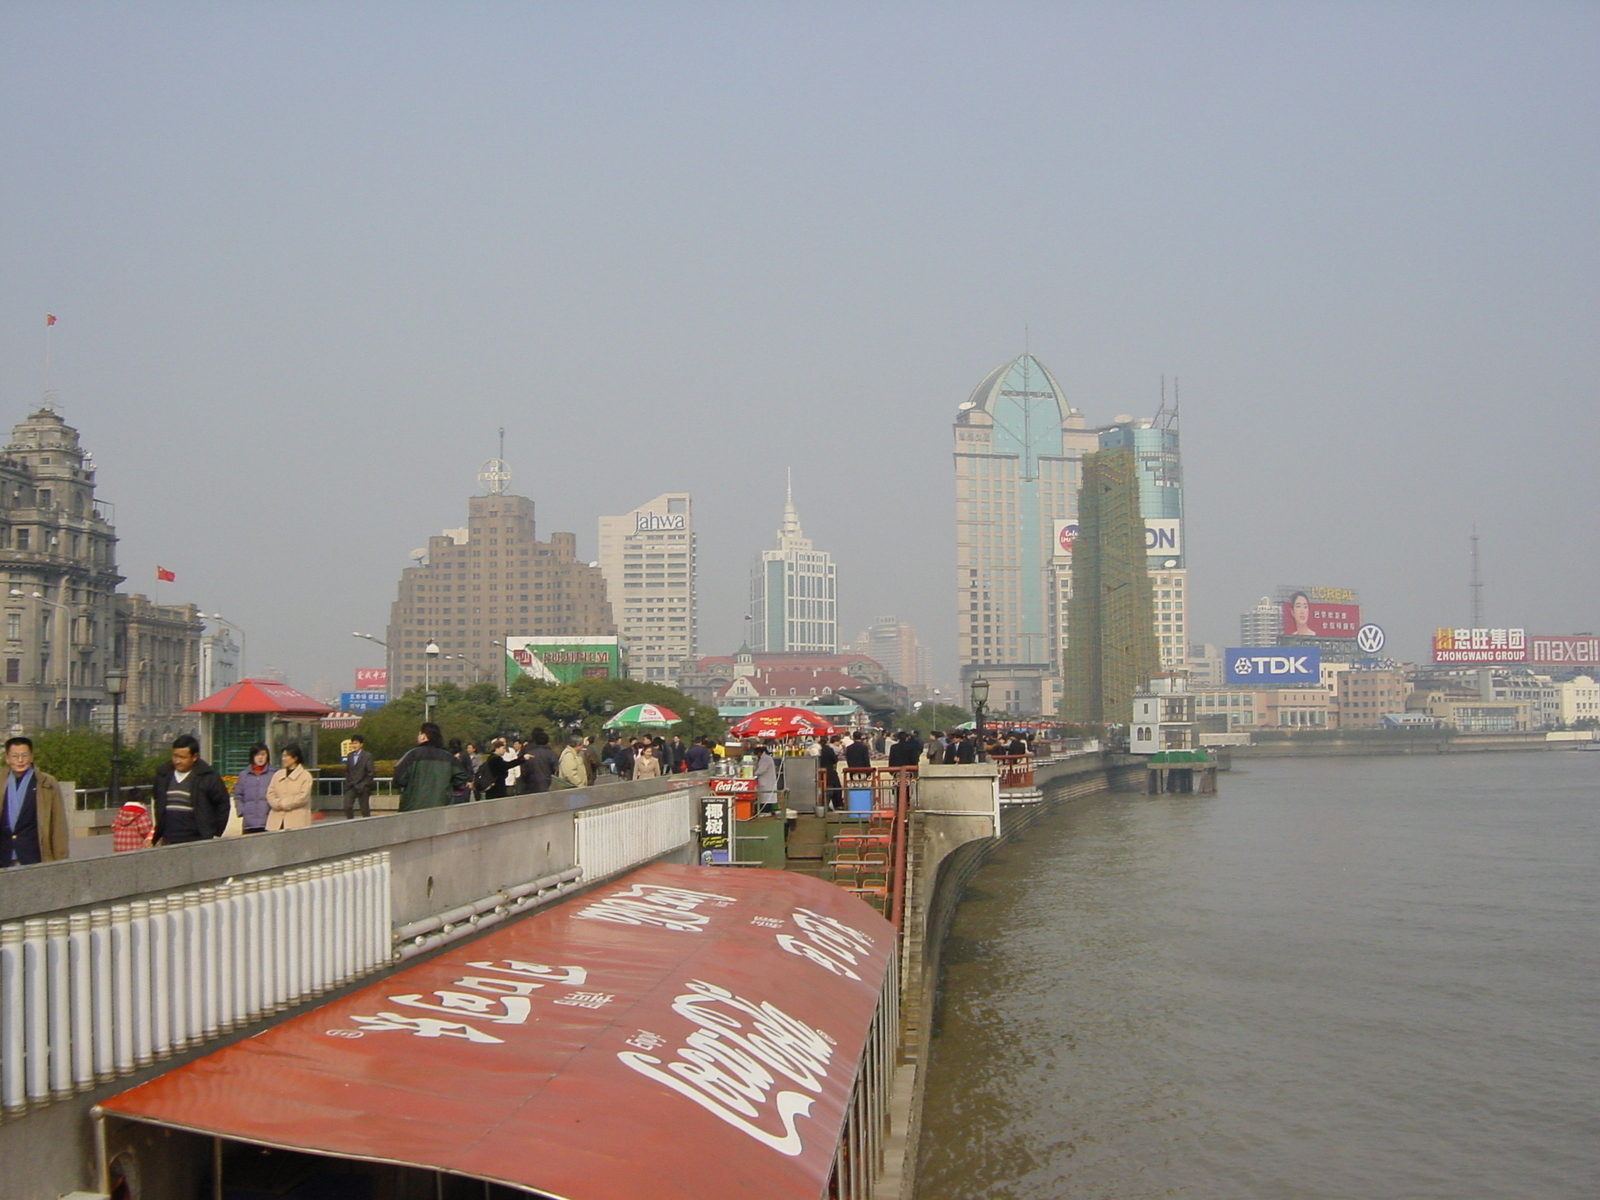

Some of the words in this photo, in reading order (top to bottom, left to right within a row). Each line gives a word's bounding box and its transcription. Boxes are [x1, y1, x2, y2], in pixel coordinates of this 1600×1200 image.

[633, 510, 685, 536] Jahwa
[1454, 628, 1525, 650] 忠旺集团
[1436, 651, 1494, 661] ZHONGWANG
[1495, 651, 1526, 661] GROUP
[1534, 640, 1599, 662] maxell
[1251, 656, 1309, 674] TDK
[617, 979, 833, 1157] Coca-Cola
